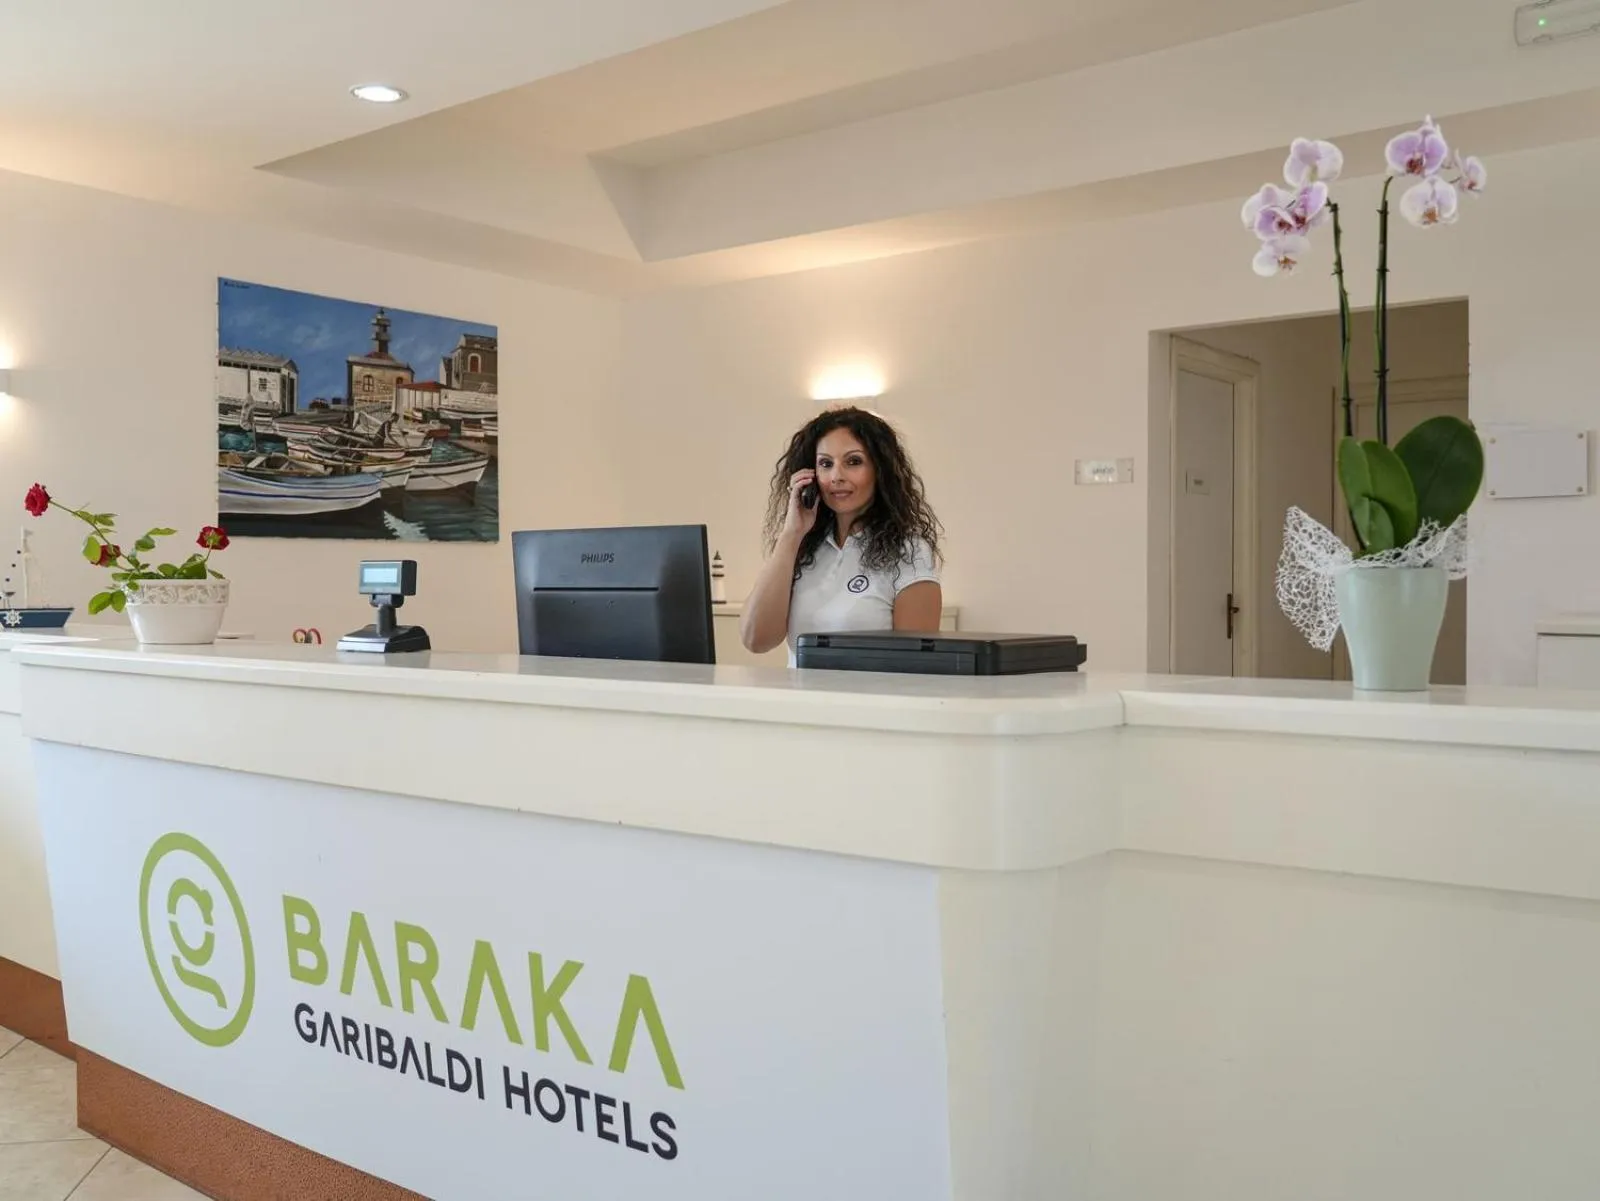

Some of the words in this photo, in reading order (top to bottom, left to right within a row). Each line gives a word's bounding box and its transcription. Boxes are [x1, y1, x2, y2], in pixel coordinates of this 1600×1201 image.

[581, 552, 615, 564] PHILIPS
[282, 895, 685, 1090] BARAKA
[294, 1001, 486, 1102] GARIBALDI
[503, 1064, 679, 1161] HOTELS
